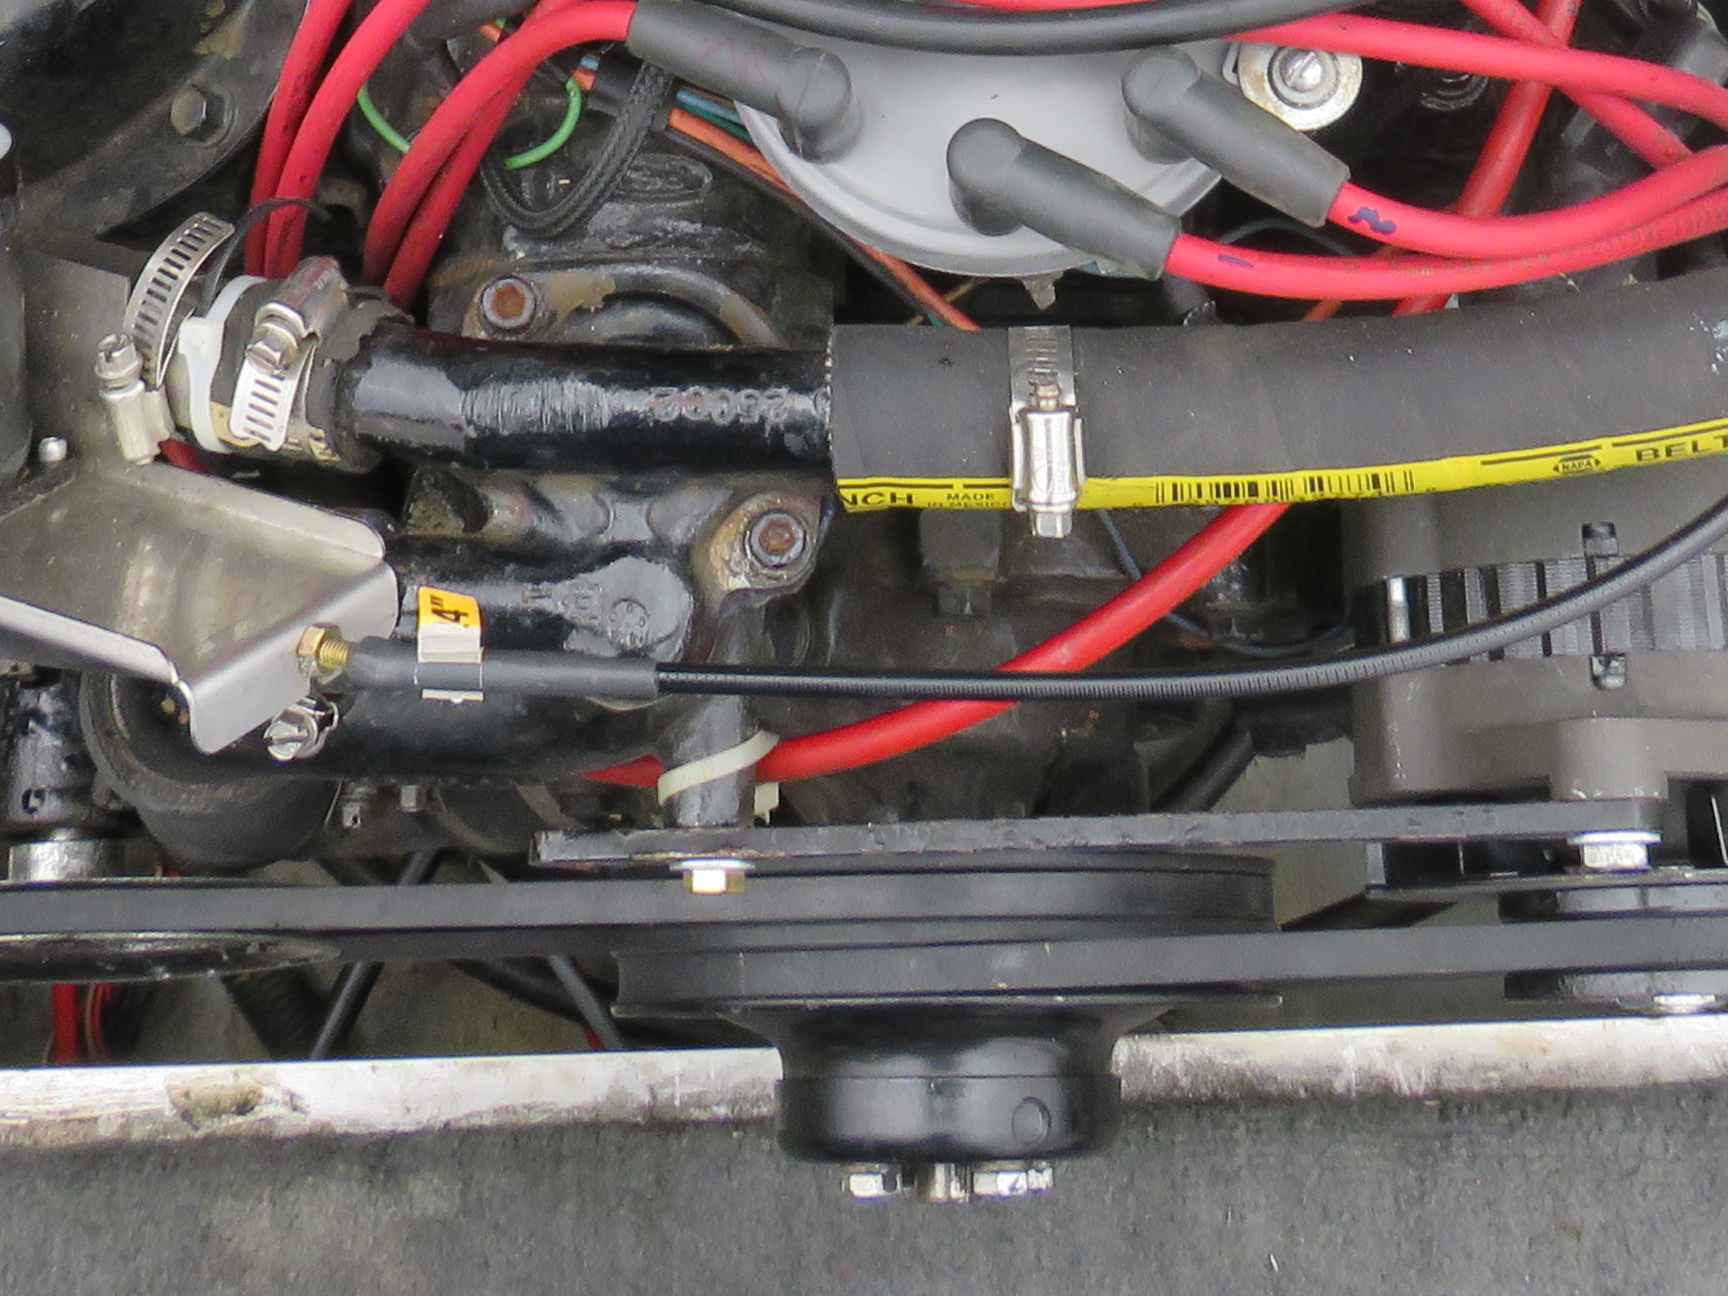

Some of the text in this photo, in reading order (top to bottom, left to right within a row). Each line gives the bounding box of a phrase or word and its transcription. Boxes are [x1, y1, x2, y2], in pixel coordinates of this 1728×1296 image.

[1560, 457, 1595, 473] NAPA
[839, 491, 997, 508] NCH MADE
